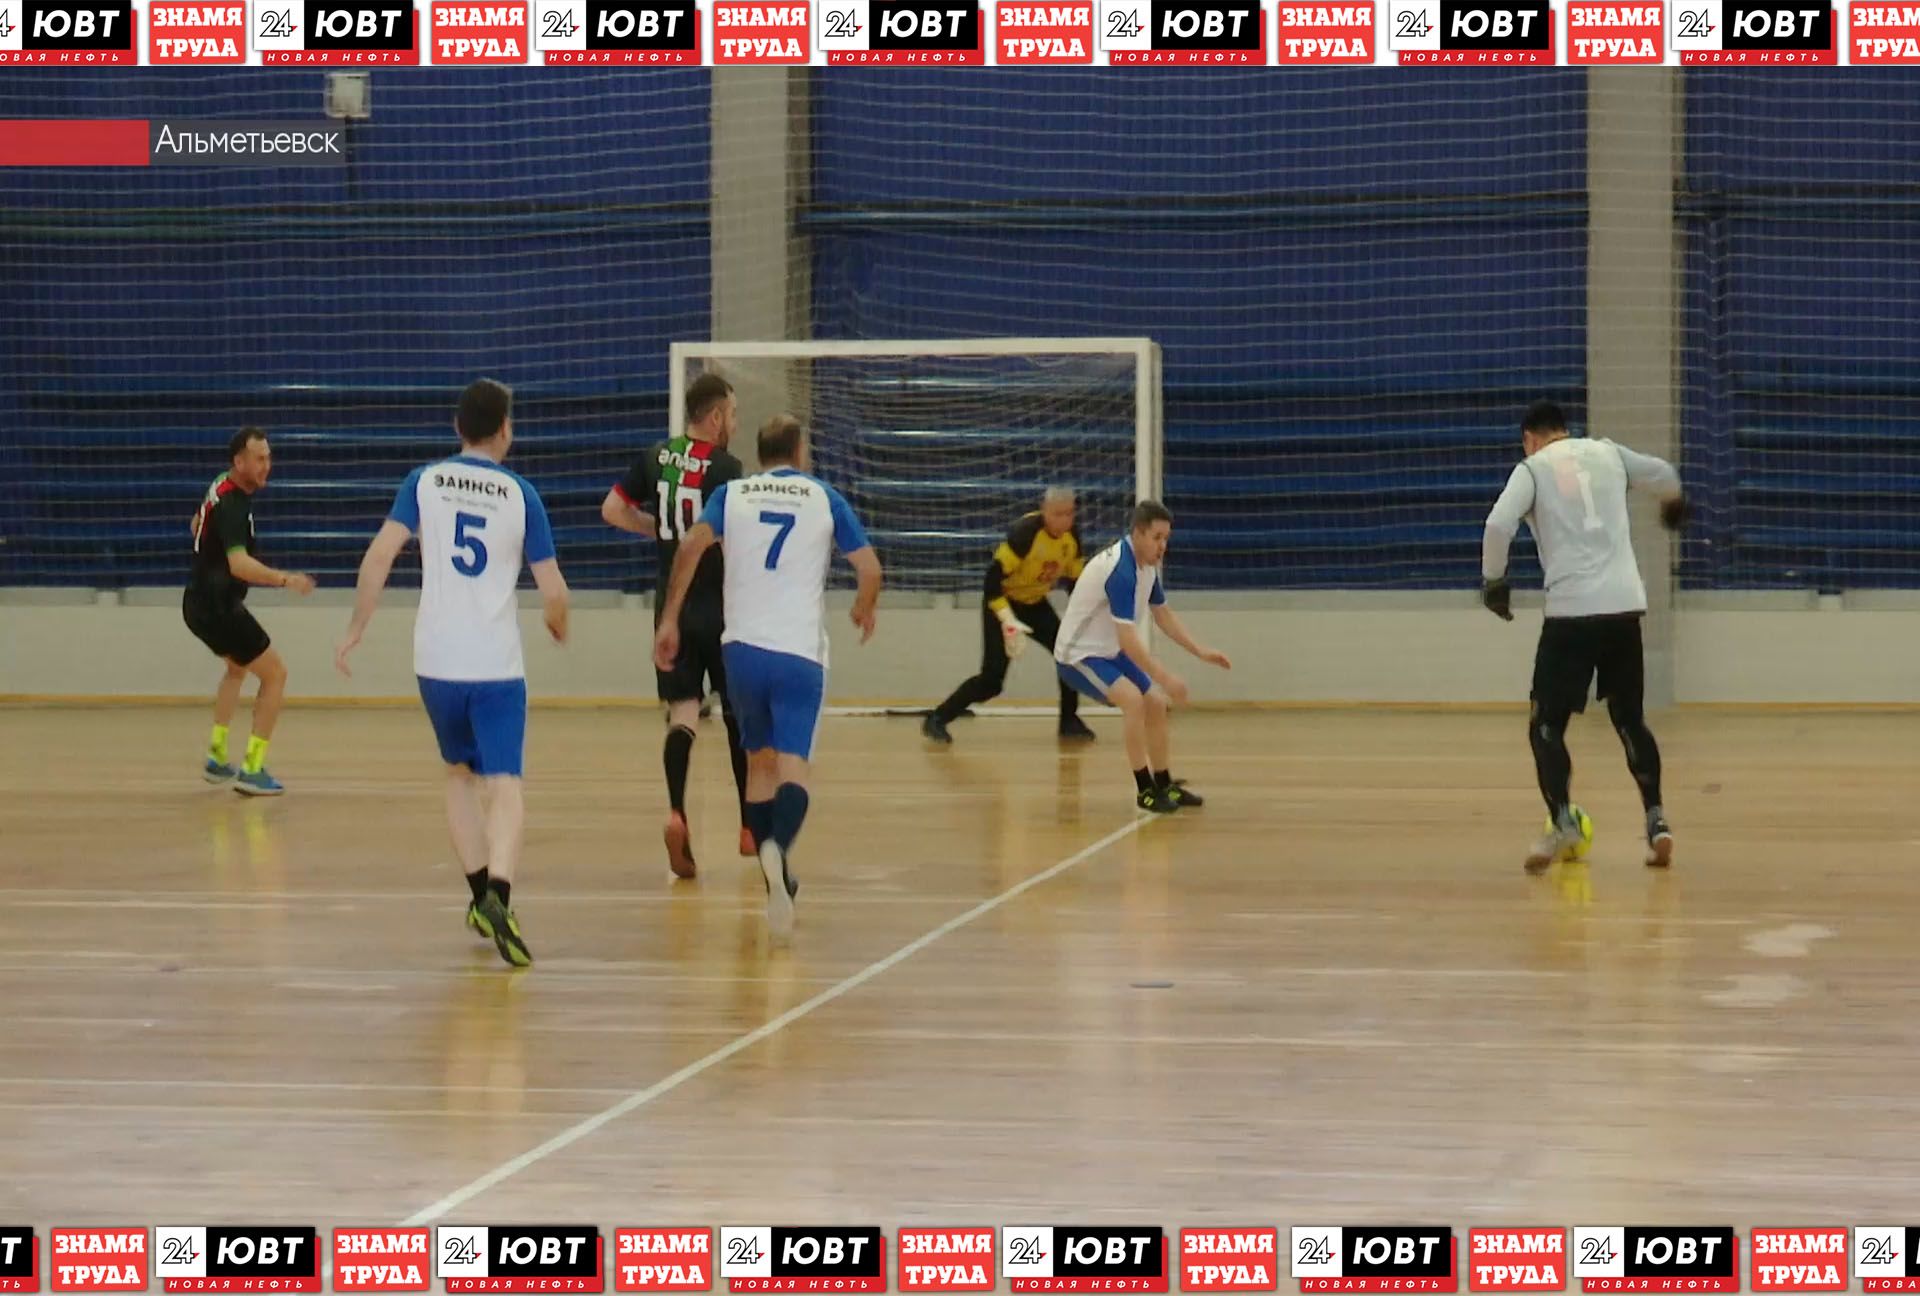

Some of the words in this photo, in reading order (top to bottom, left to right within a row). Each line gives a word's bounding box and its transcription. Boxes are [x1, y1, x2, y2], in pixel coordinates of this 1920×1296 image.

[433, 474, 508, 500] ЗАИНСК
[656, 481, 703, 541] 10
[740, 483, 811, 498] ЗАИНСК
[1576, 471, 1604, 530] 1
[451, 510, 488, 578] 5
[759, 510, 796, 571] 7
